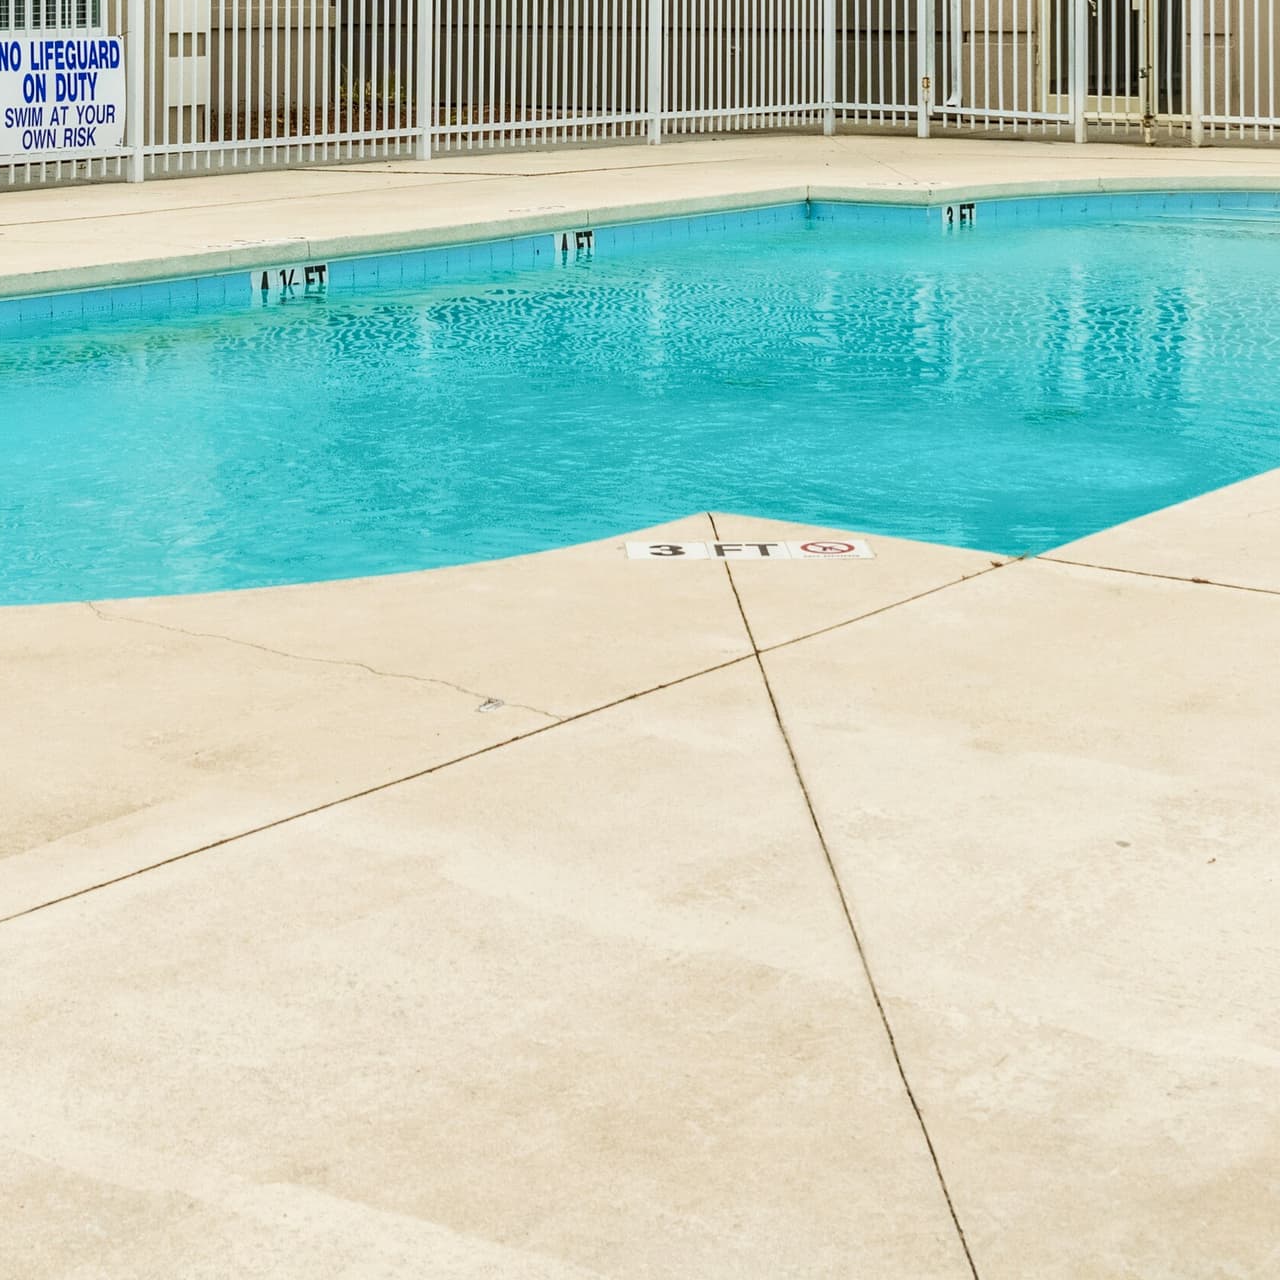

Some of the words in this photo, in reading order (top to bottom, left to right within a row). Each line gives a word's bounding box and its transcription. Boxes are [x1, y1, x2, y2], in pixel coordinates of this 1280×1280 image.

[30, 40, 120, 70] LIFEGUARD
[23, 73, 46, 103] ON
[56, 72, 98, 102] DUTY
[4, 106, 43, 128] SWIM
[50, 106, 69, 126] AT
[76, 104, 115, 125] YOUR
[22, 129, 56, 150] OWN
[64, 126, 96, 147] RISK
[648, 544, 686, 557] 3
[713, 543, 778, 557] FT
